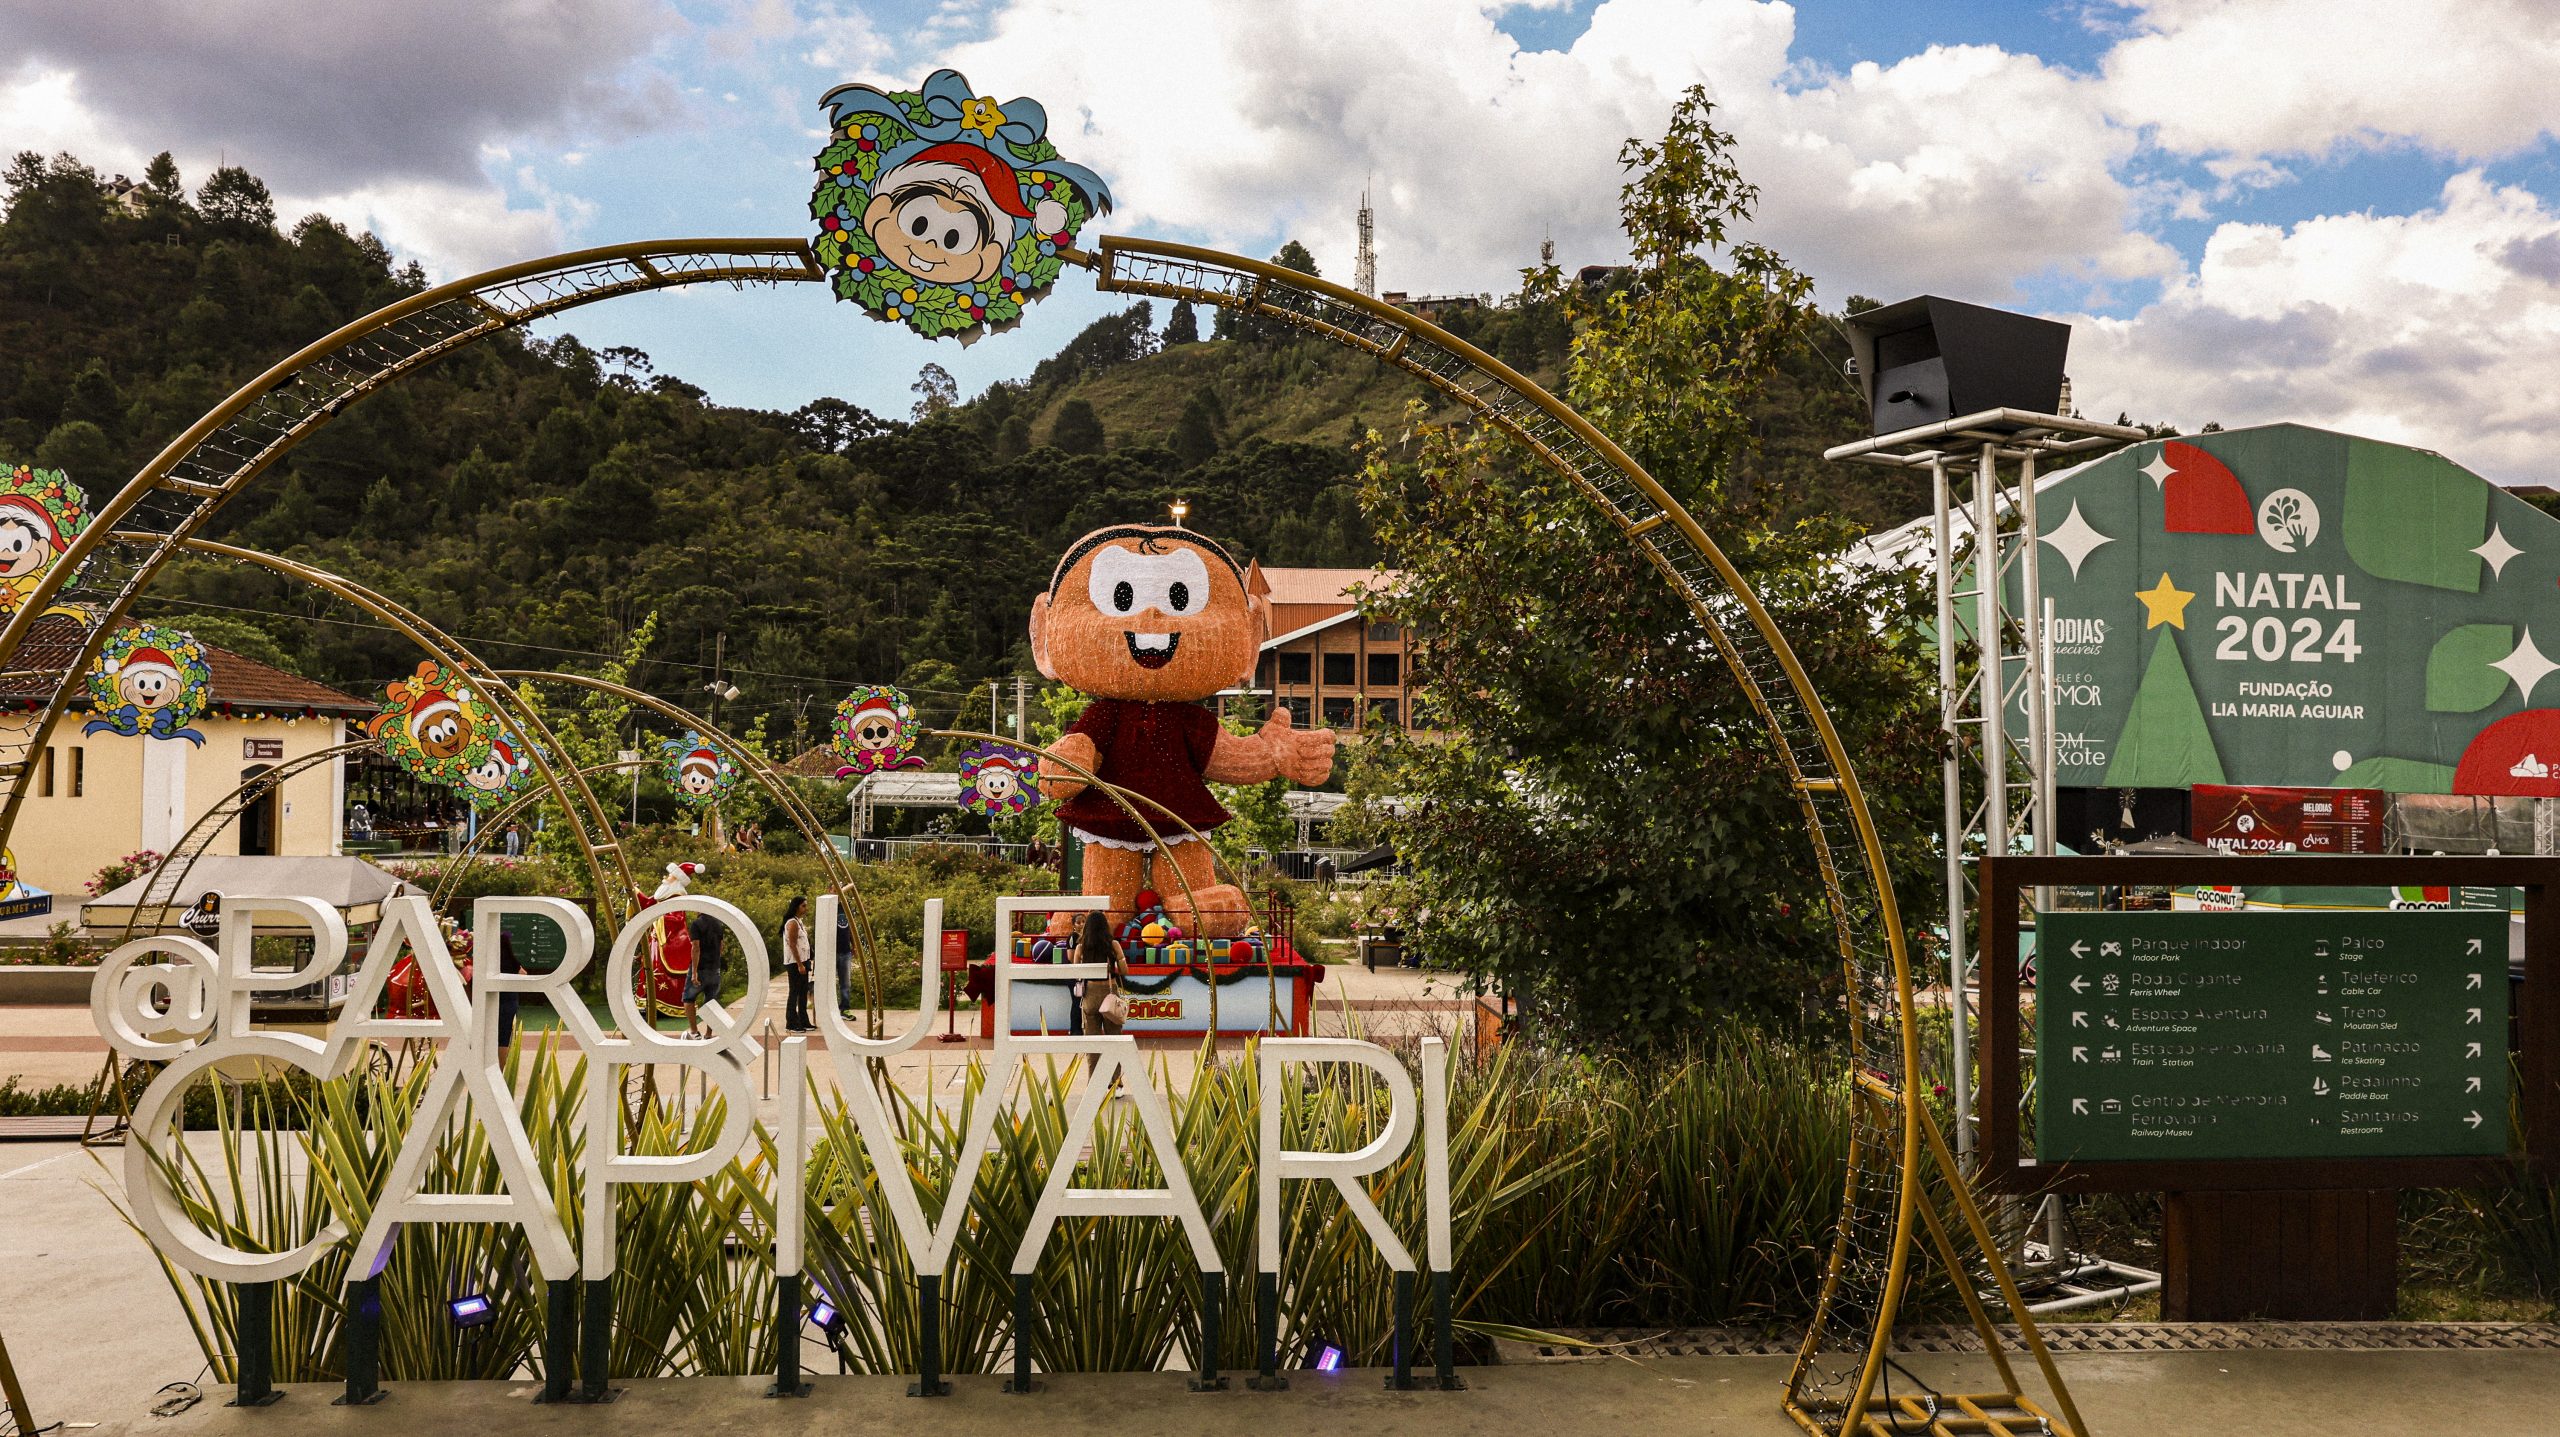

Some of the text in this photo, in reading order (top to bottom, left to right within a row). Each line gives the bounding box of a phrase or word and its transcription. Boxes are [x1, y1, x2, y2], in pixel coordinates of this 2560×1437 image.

[2216, 572, 2360, 610] NATAL
[2216, 616, 2362, 663] 2024
[2239, 681, 2333, 700] FUNDAÇÃO
[2212, 703, 2364, 719] LIA MARIA AGUIAR
[2303, 803, 2332, 813] MELODIAS
[2250, 840, 2285, 850] 2024
[2196, 891, 2236, 905] COCONUT
[2131, 937, 2247, 951] Parque Indoor
[2342, 936, 2385, 949] Palco
[2132, 954, 2180, 962] Indoor Park
[2339, 953, 2364, 961] Stage
[2132, 972, 2172, 985] Roda
[2130, 988, 2181, 996] Ferris Wheel
[2367, 987, 2382, 995] Car
[1126, 998, 1181, 1018] ônica
[2341, 1006, 2386, 1019] Treno
[2126, 1024, 2198, 1033] Adventure Space
[2343, 1022, 2398, 1030] Moutain Sled
[2132, 1058, 2194, 1067] Train Station
[2341, 1057, 2386, 1066] Ice Skating
[2131, 1094, 2186, 1107] Centro
[2339, 1092, 2389, 1100] Paddle Boat
[2131, 1128, 2193, 1138] Railway Museu
[2340, 1126, 2384, 1135] Restrooms
[124, 1034, 1453, 1284] CAPIVARI
